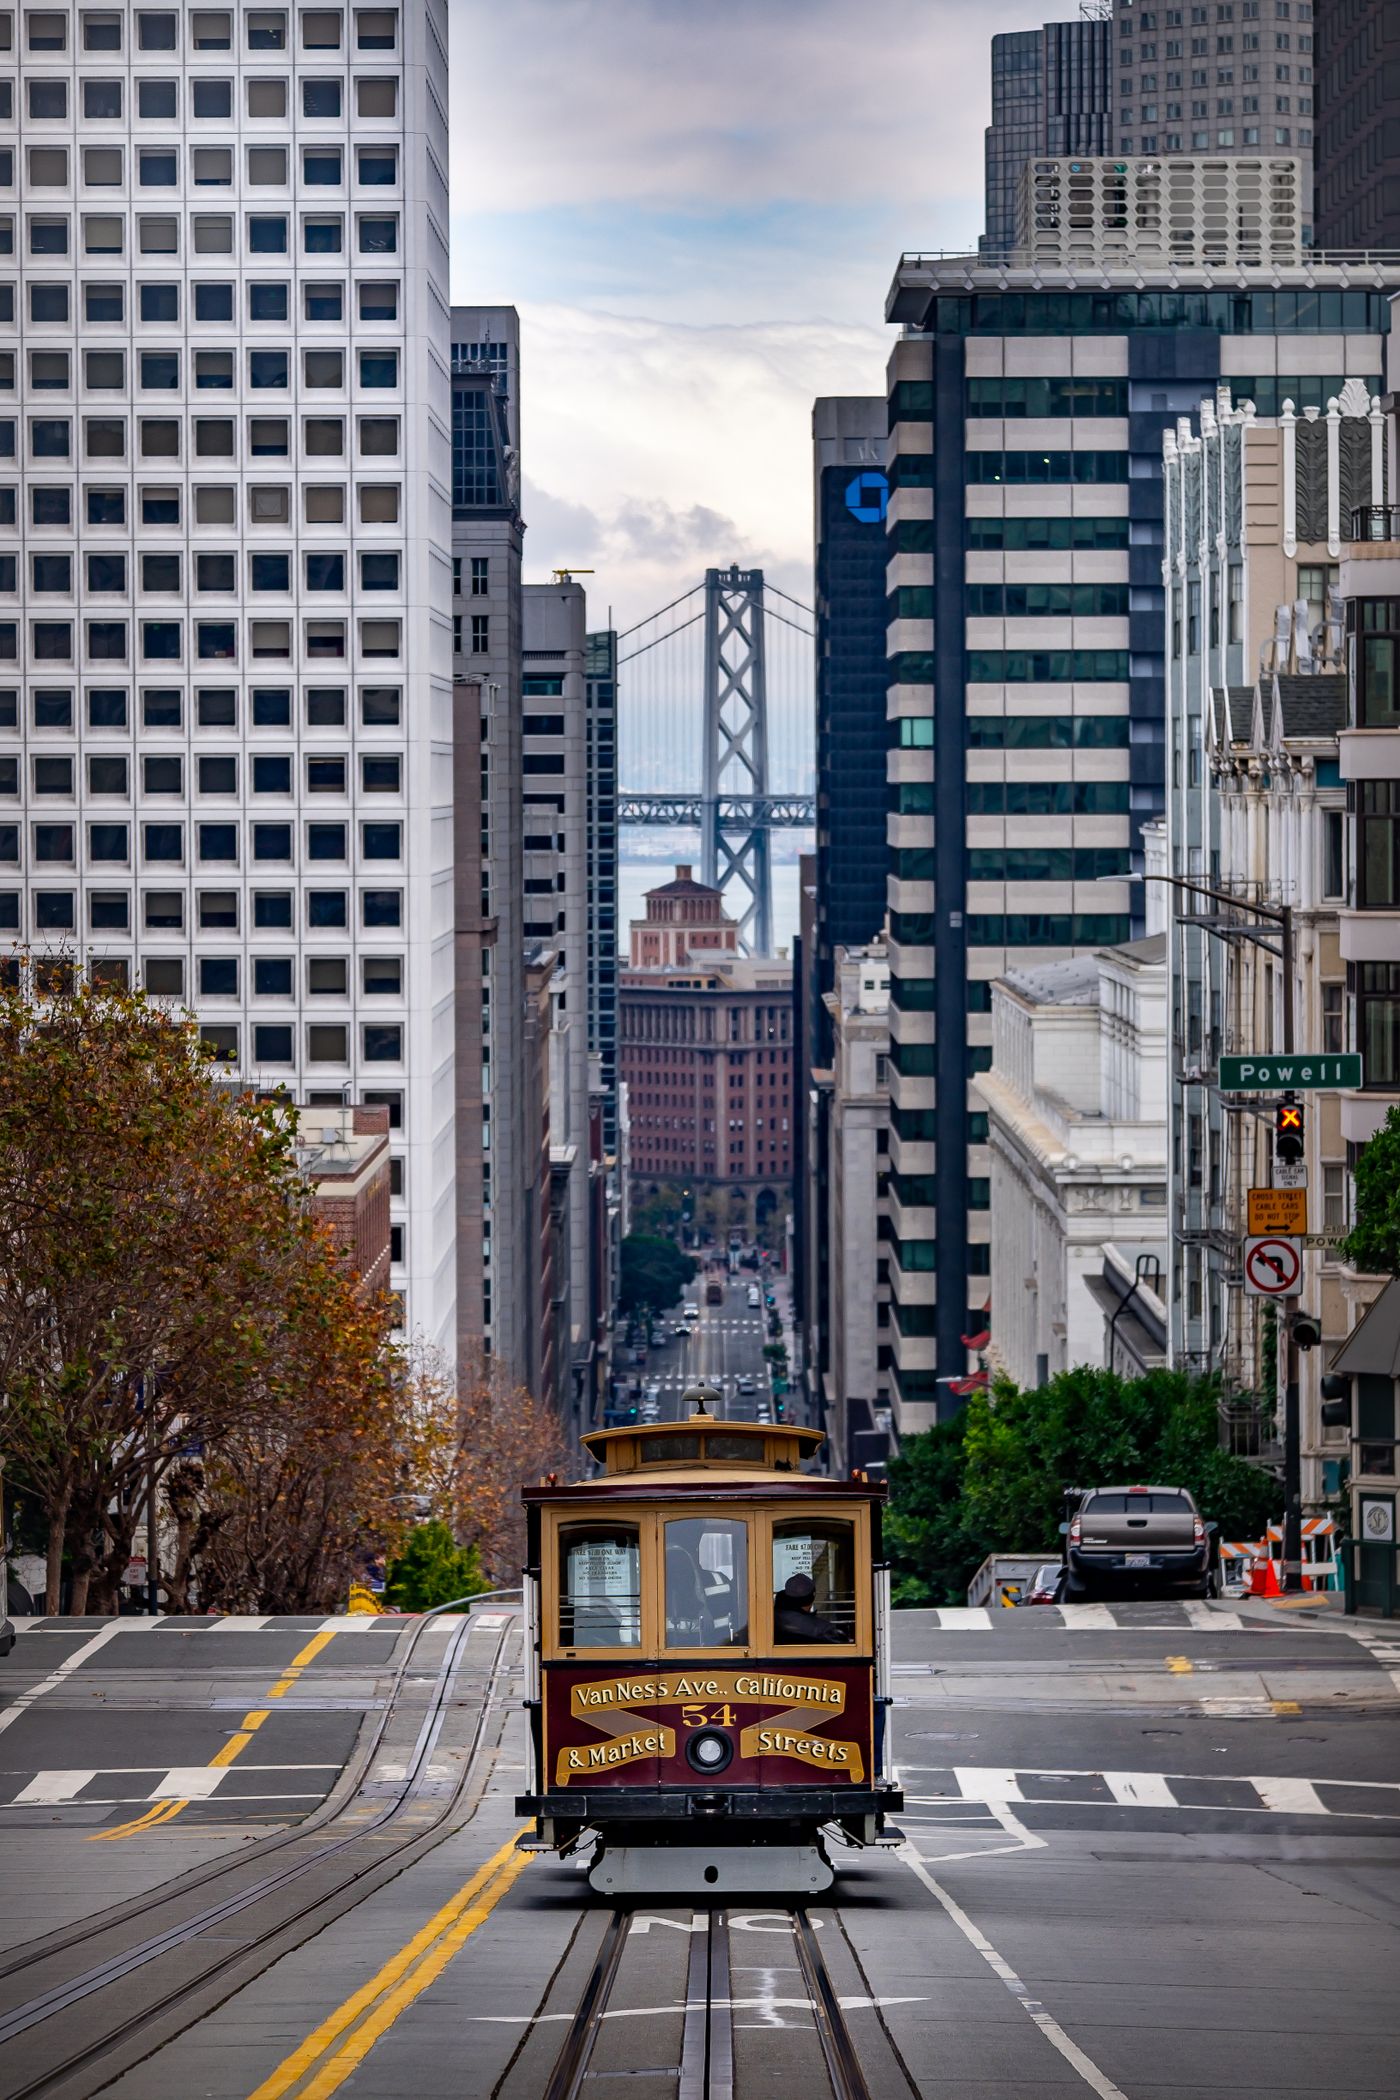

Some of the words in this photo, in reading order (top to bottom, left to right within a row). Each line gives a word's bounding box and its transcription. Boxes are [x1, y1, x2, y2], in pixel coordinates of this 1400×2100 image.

[1240, 1063, 1341, 1082] Powell
[1252, 1193, 1273, 1201] CROSS
[1278, 1192, 1302, 1201] STREET
[1255, 1202, 1276, 1211] CABLE
[1281, 1202, 1299, 1210] CARS
[1254, 1213, 1264, 1221] DO
[1267, 1212, 1280, 1220] NOT
[1284, 1212, 1300, 1220] STOP
[577, 1687, 614, 1706] Van
[615, 1681, 669, 1702] Ness
[735, 1677, 842, 1704] California
[681, 1703, 737, 1728] 54
[568, 1749, 585, 1768] &
[588, 1733, 665, 1767] Market
[758, 1731, 849, 1763] Streets
